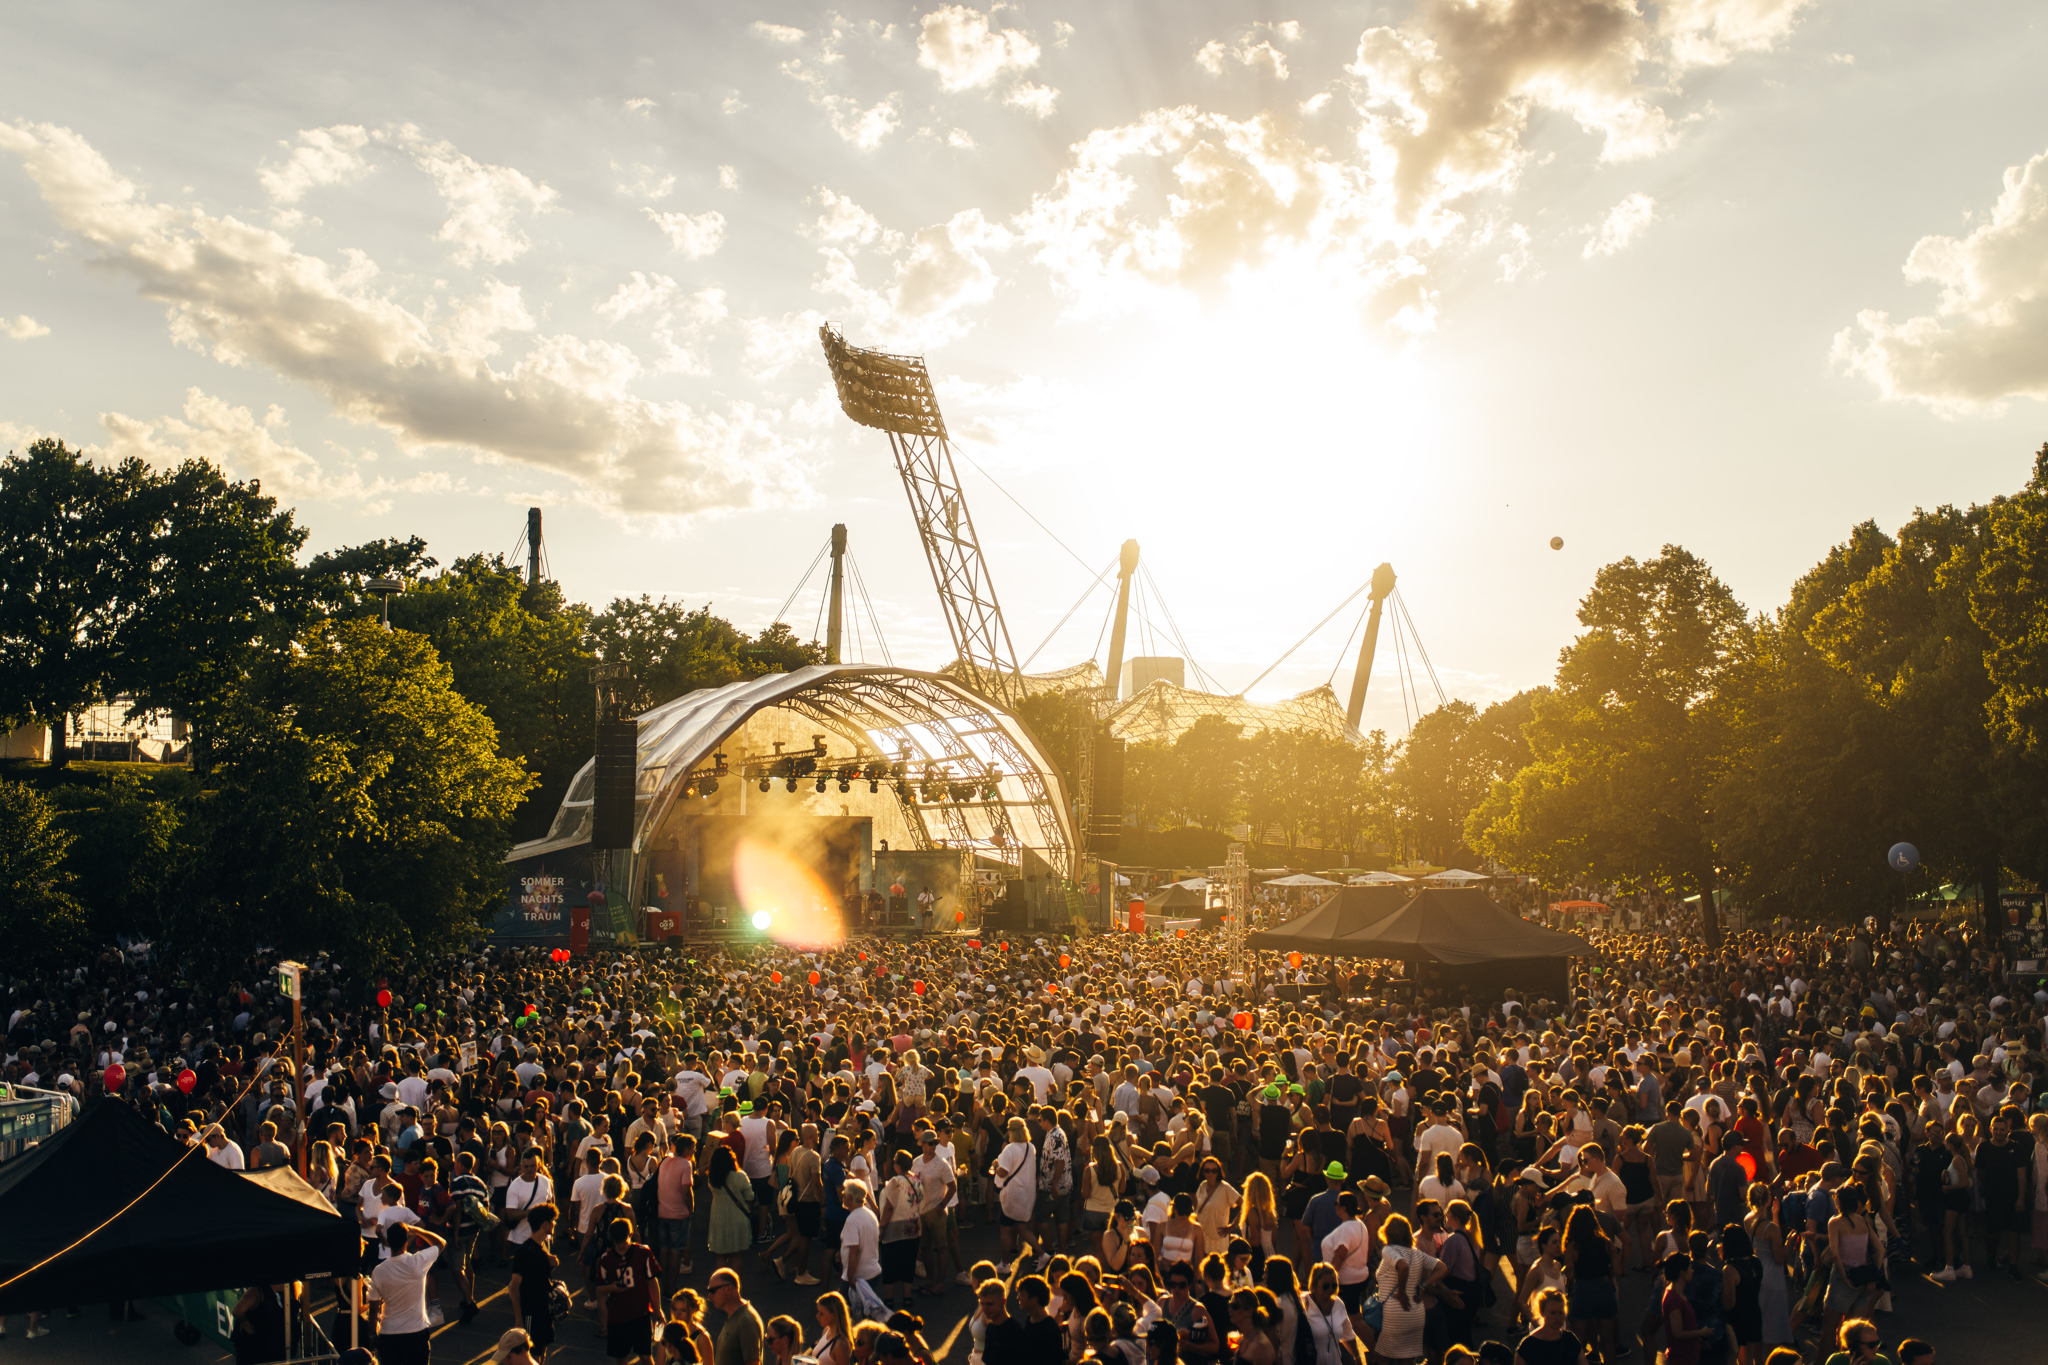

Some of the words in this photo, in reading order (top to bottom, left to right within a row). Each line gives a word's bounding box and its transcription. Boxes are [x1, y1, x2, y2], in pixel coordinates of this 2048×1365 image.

[521, 877, 564, 886] SOMMER
[521, 895, 564, 904] NACHTS
[523, 912, 561, 921] TRAUM
